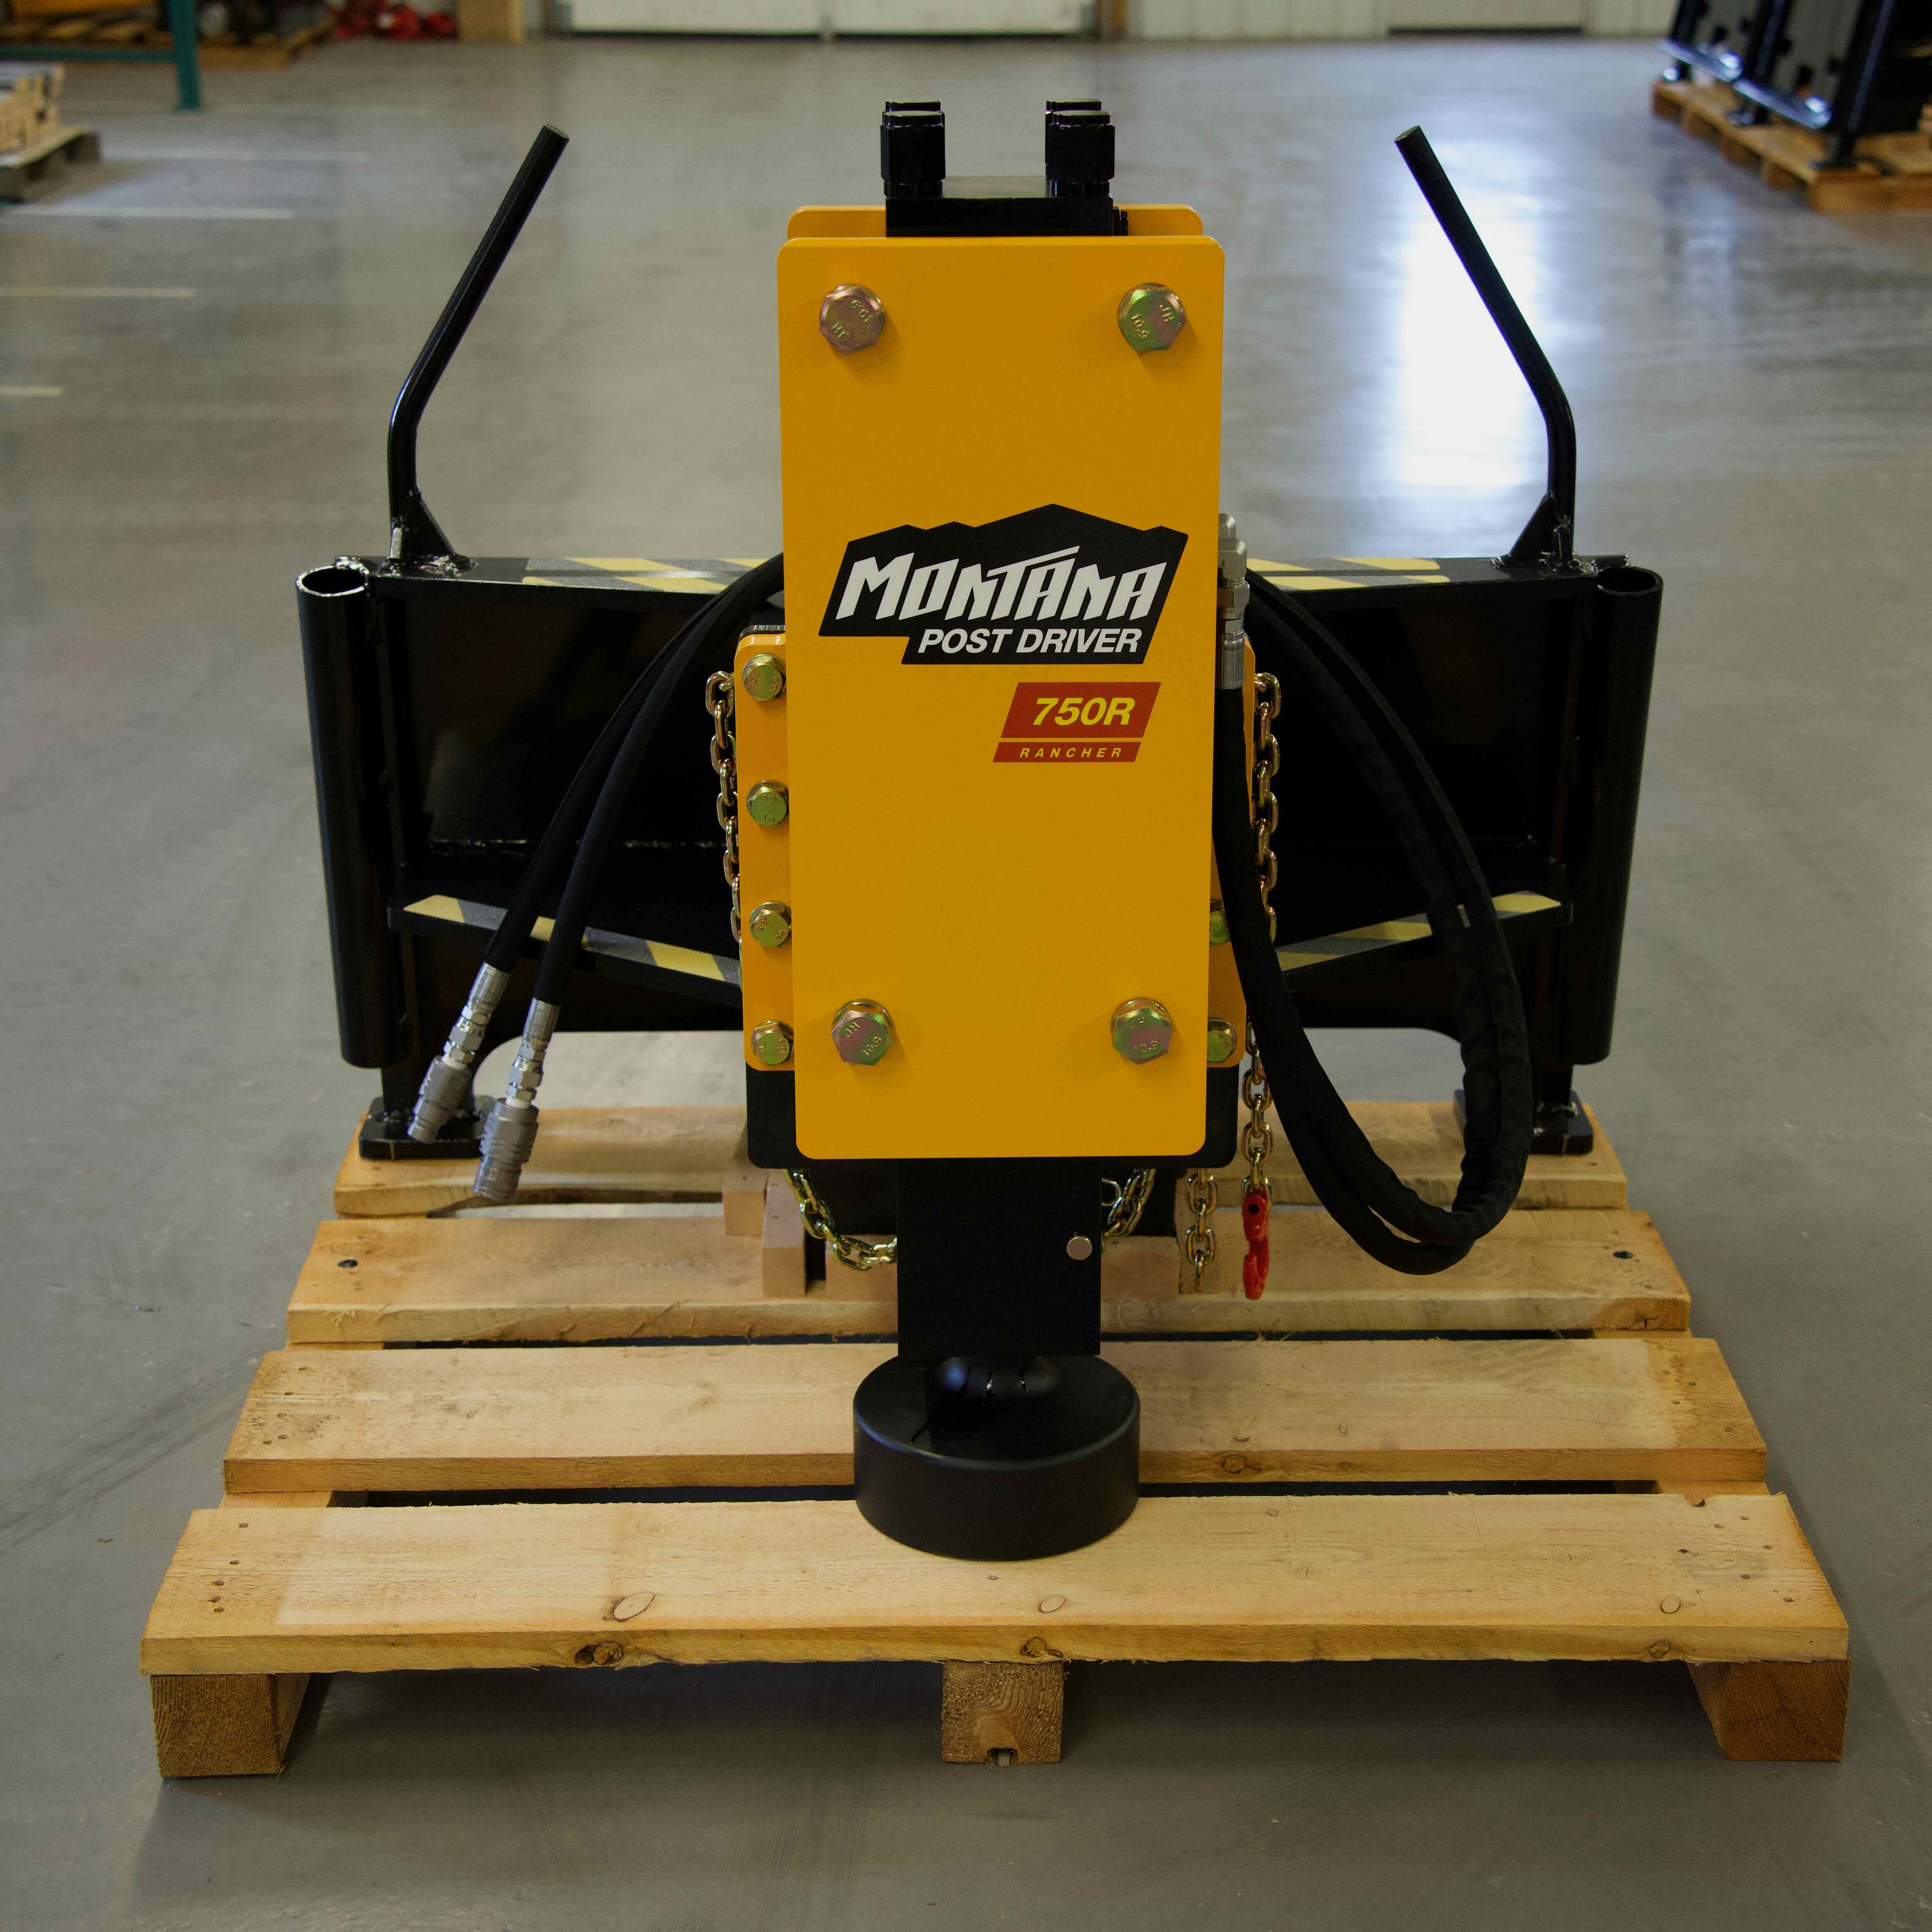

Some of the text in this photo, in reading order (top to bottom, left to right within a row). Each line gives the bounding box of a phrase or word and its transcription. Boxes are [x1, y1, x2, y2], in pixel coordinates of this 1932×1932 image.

[1131, 313, 1149, 338] 10.9
[836, 546, 1167, 620] MONTANA
[918, 629, 1142, 653] POST DRIVER
[1033, 697, 1135, 725] 750R
[1020, 748, 1121, 758] RANCHER
[862, 1035, 882, 1056] 10.9
